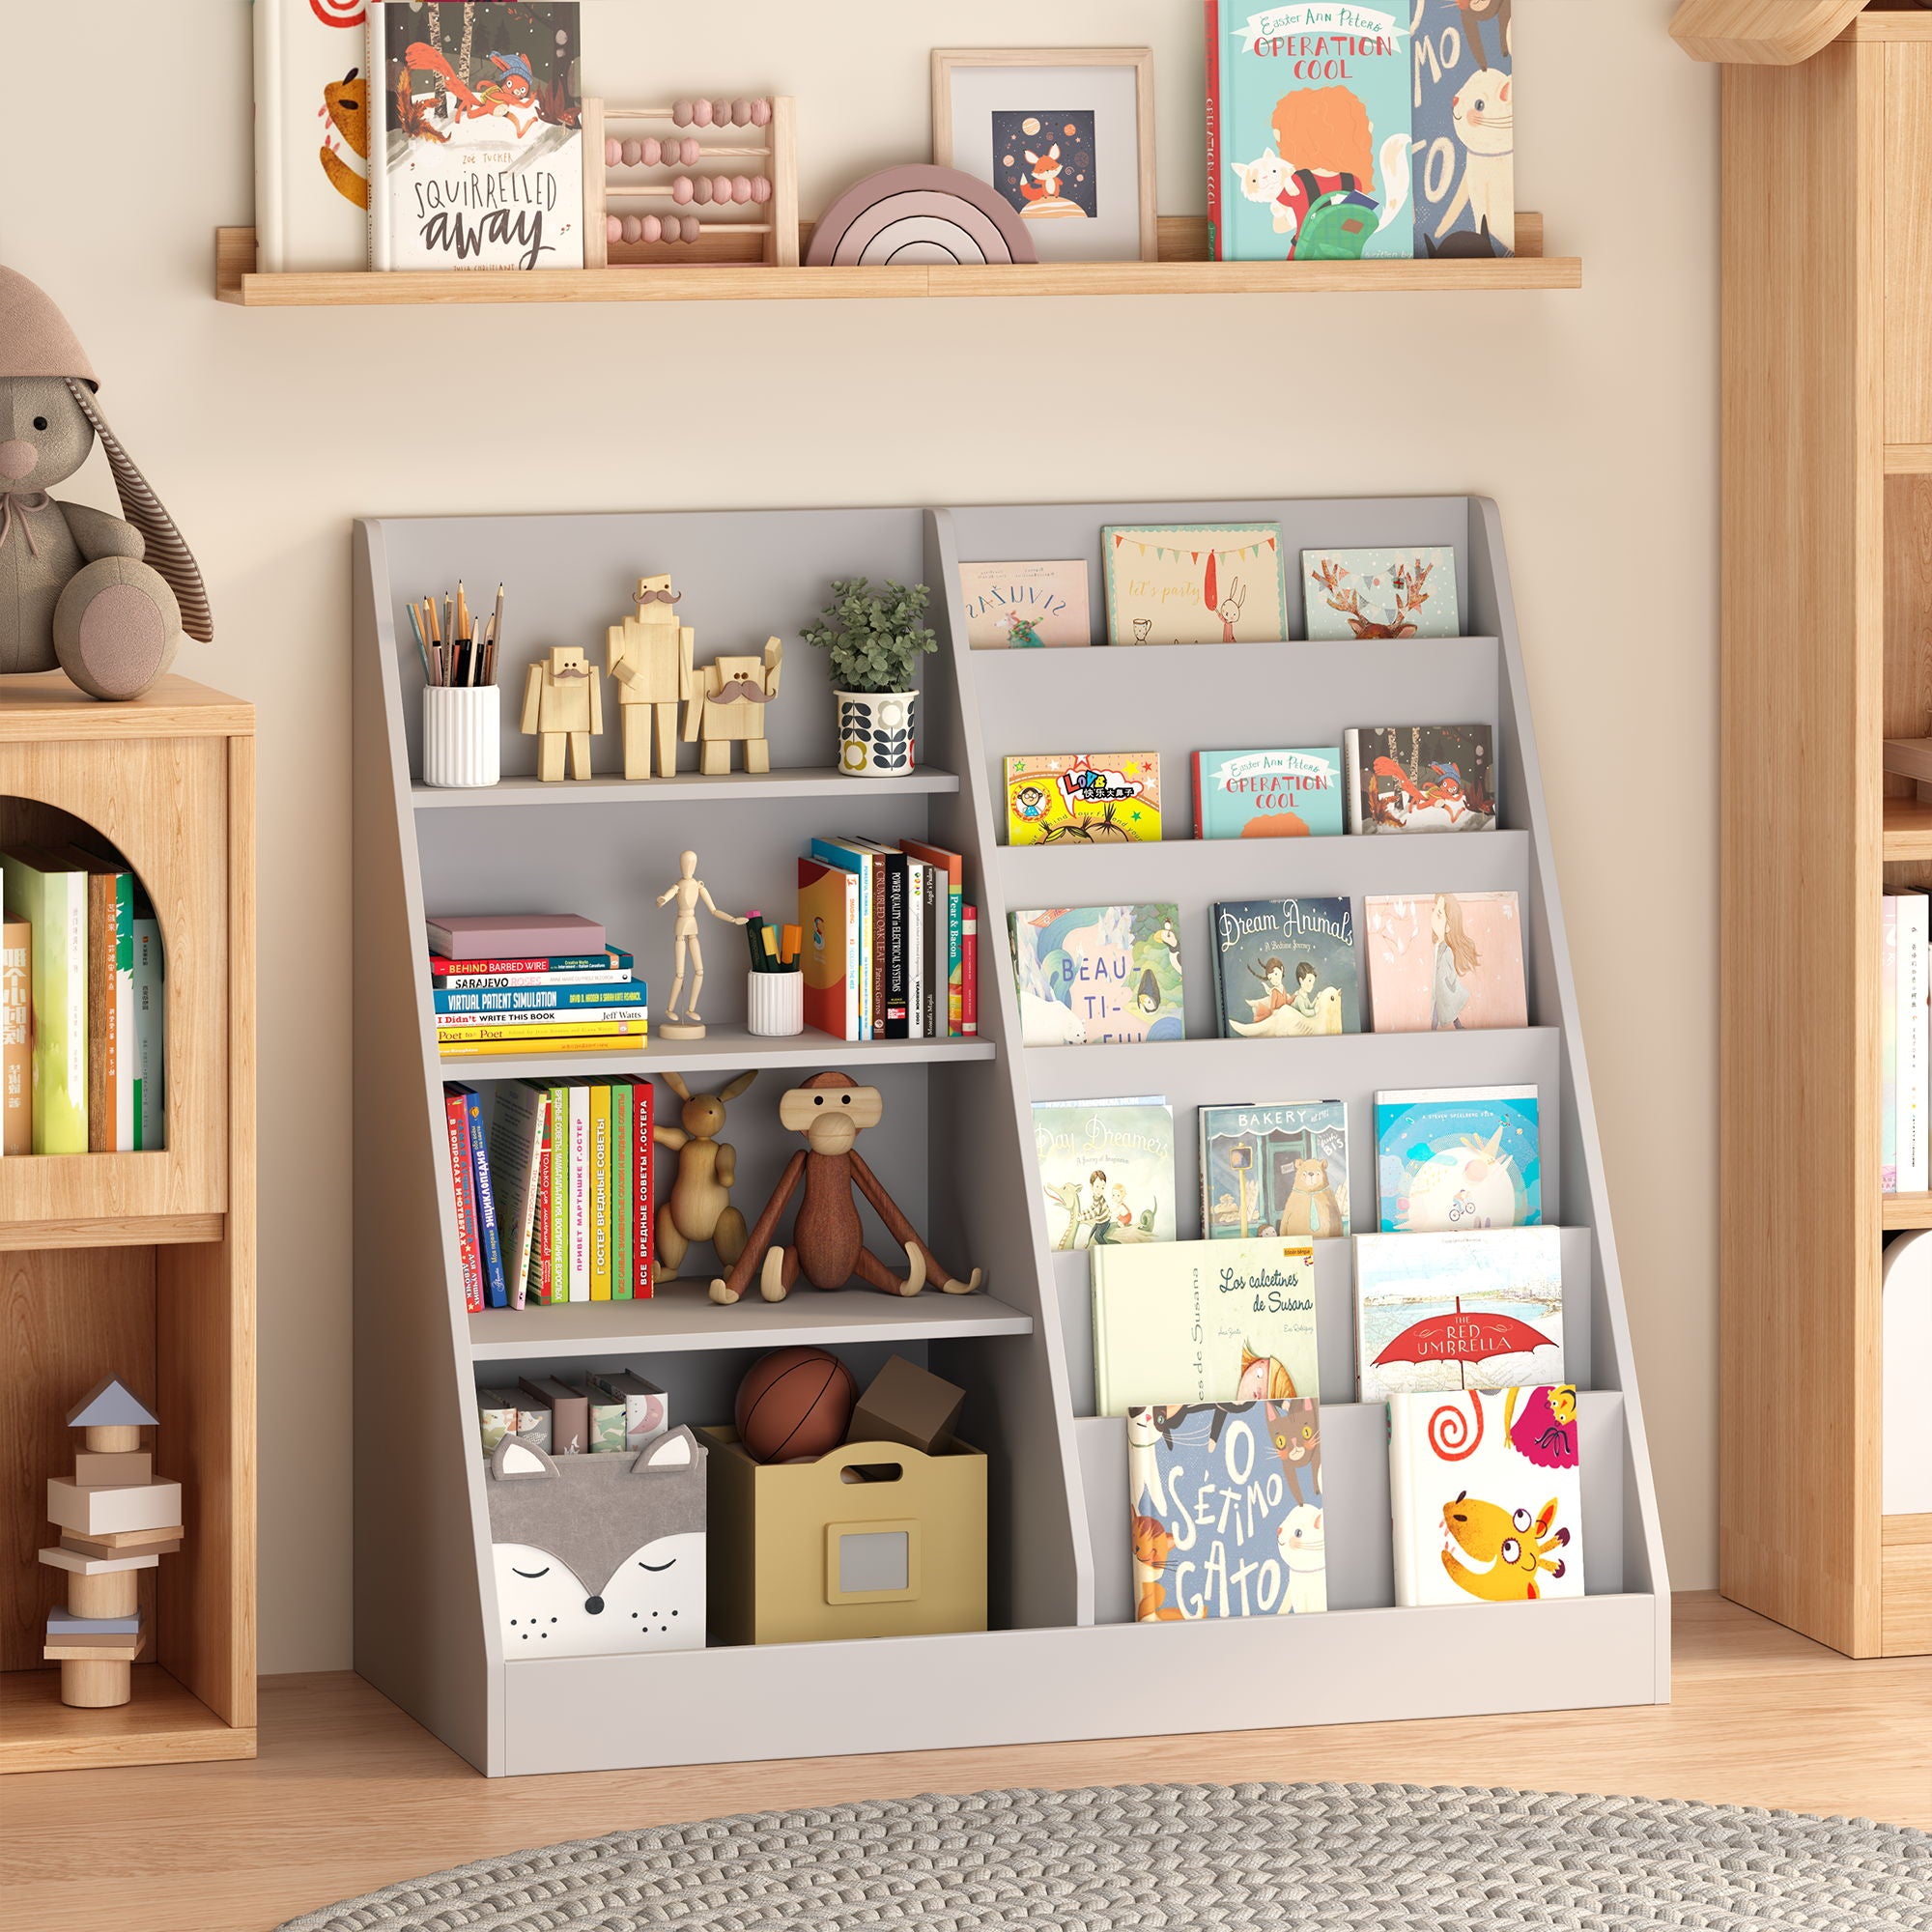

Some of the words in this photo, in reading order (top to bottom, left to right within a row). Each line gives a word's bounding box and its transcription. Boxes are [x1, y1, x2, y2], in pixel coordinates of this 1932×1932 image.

[1253, 36, 1392, 57] OPERATION
[1293, 59, 1353, 80] COOL
[483, 153, 515, 163] TUCKER
[419, 208, 556, 270] away
[1161, 580, 1201, 606] party
[1082, 787, 1135, 800] 快乐大鼻子
[1226, 776, 1327, 793] OPERATION
[1256, 793, 1299, 809] COOL
[892, 872, 900, 893] POWER
[876, 870, 886, 918] CRUMBLED
[891, 894, 901, 921] QUALITY
[876, 919, 886, 940] OAK
[1219, 908, 1280, 952] Dream
[1283, 898, 1353, 946] Animals
[876, 941, 886, 962] LEAF
[892, 926, 901, 963] ELECTRICAL
[951, 930, 959, 957] Bacon
[449, 963, 488, 974] BEHIND
[489, 962, 524, 973] BARBED
[525, 961, 547, 971] WIRE
[892, 964, 901, 992] SYSTEMS
[1063, 955, 1141, 981] BEAU-
[455, 978, 509, 989] SARAJEVO
[448, 993, 480, 1010] VIRTUAL
[482, 992, 512, 1009] PATIENT
[513, 991, 556, 1008] SIMULATION
[1084, 996, 1121, 1019] TI-
[444, 1015, 476, 1024] Didn't
[601, 1011, 617, 1021] Jeff
[619, 1010, 641, 1019] Watts
[439, 1031, 462, 1040] Poet
[480, 1030, 502, 1038] Poet
[1238, 1110, 1306, 1127] BAKERY
[1083, 1113, 1168, 1158] Dreamers
[450, 1129, 462, 1183] ВОПРОСАХ
[457, 1200, 467, 1245] ОТВЕТАХ
[476, 1151, 495, 1228] ЭНЦИКЛОПЕДИЯ
[597, 1170, 606, 1226] ВРЕДНЫЕ
[471, 1272, 480, 1305] ЛУЧШИХ
[1219, 1266, 1246, 1293] Los
[1249, 1267, 1298, 1289] calcetines
[1191, 1267, 1204, 1344] Susana
[1253, 1293, 1265, 1312] de
[1267, 1291, 1313, 1313] Susana
[1454, 1316, 1470, 1324] THE
[1447, 1324, 1481, 1339] RED
[1417, 1337, 1512, 1355] UMBRELLA
[1193, 1351, 1203, 1375] de
[1225, 1420, 1255, 1485] O
[1176, 1540, 1281, 1619] GATO
